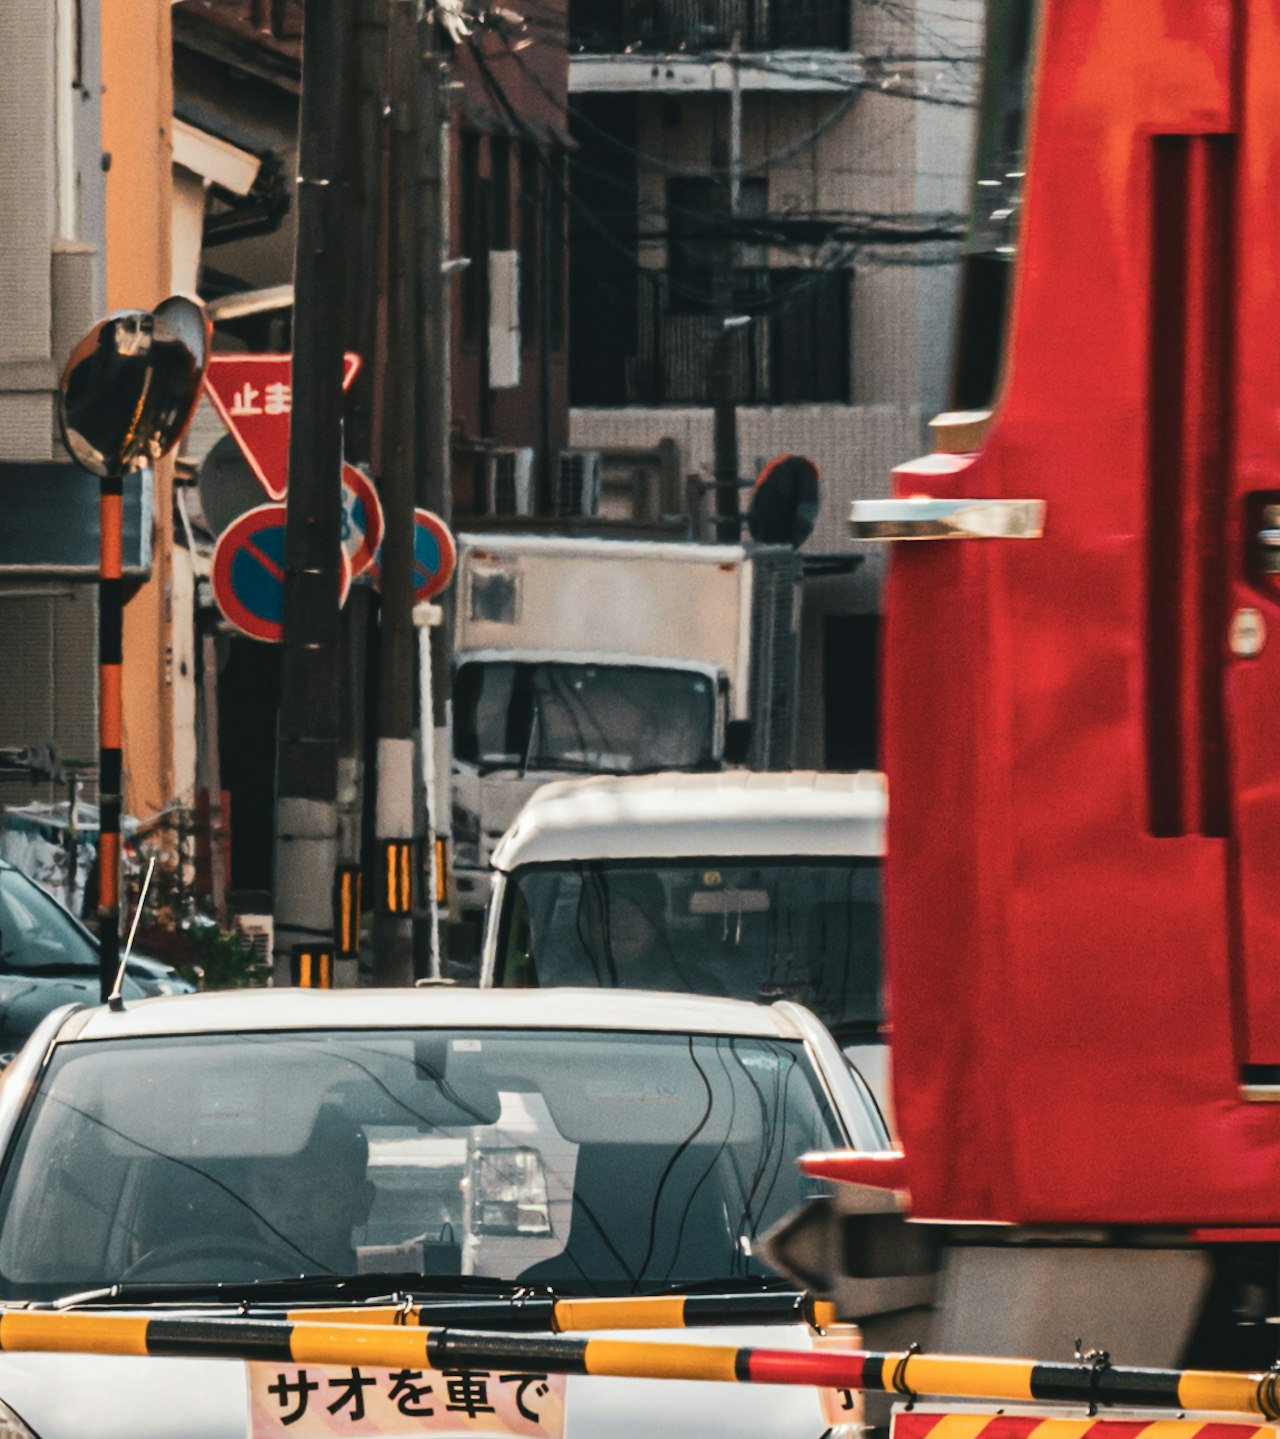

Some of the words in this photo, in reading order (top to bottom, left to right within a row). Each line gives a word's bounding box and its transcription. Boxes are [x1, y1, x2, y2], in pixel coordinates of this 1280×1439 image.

[230, 382, 292, 416] 止ま
[267, 1366, 550, 1426] サオを車で
